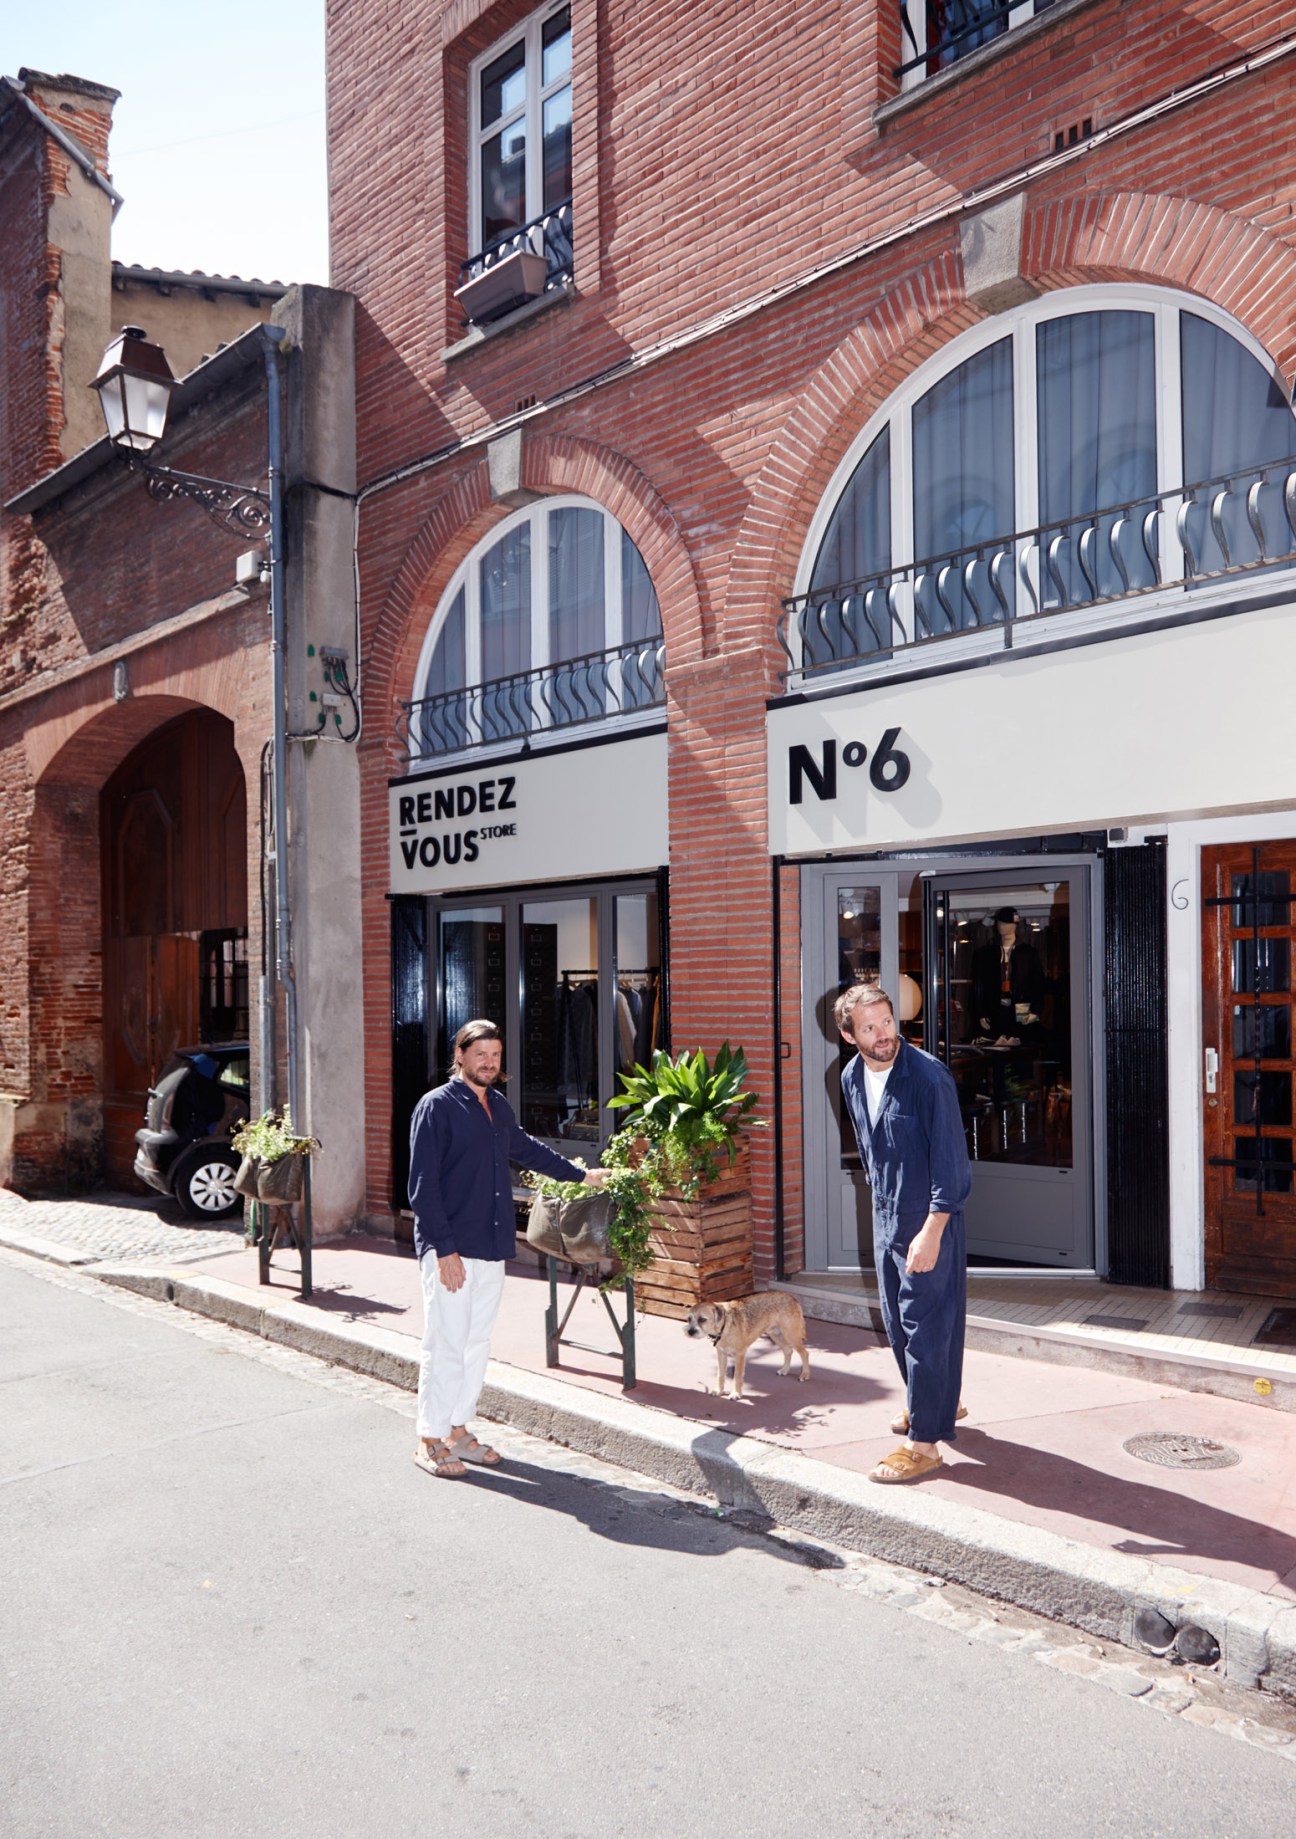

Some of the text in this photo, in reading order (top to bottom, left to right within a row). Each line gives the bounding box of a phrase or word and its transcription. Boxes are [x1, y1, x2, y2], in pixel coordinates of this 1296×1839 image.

[399, 776, 517, 827] RENDEZ
[400, 822, 517, 870] VOUS STORE
[1171, 878, 1190, 911] 6
